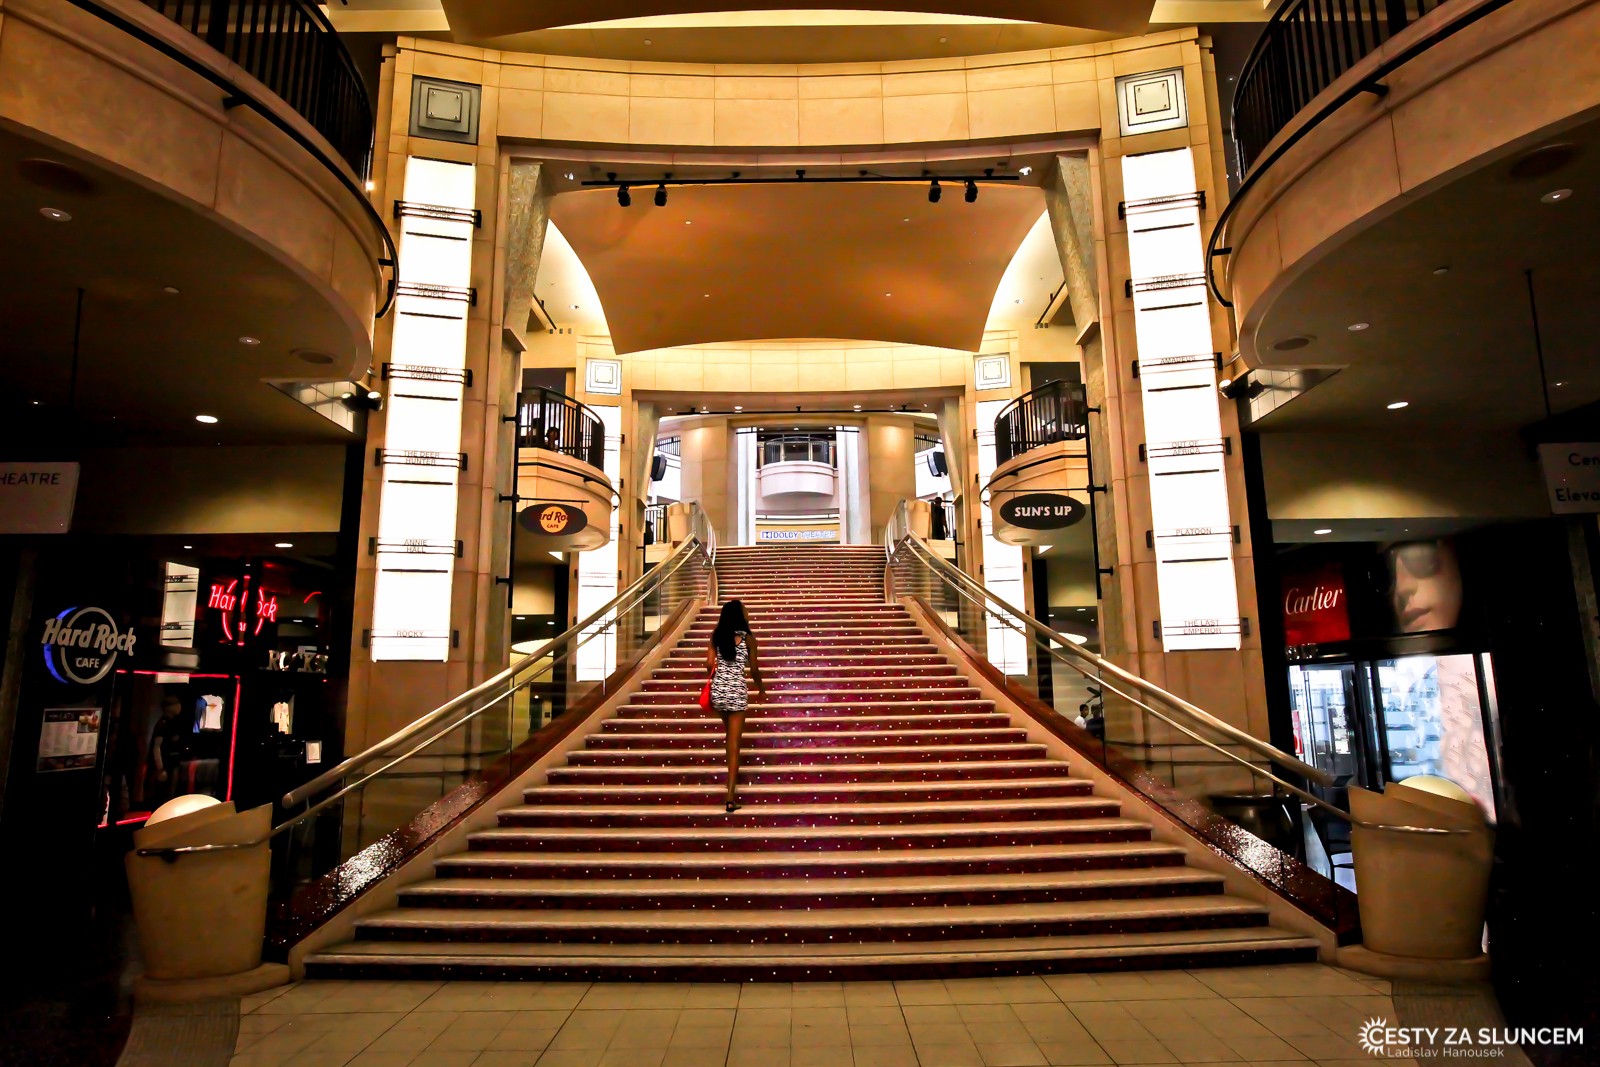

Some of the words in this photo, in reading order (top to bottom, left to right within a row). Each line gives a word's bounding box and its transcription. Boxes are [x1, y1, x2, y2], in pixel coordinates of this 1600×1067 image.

[1172, 447, 1201, 456] AFRICA
[1014, 506, 1051, 517] SUN'S
[1054, 505, 1073, 516] UP
[773, 531, 798, 539] DOLBY
[1175, 528, 1212, 536] PLATOON
[1285, 586, 1343, 615] Cartier
[1200, 619, 1220, 627] LAST
[1183, 627, 1222, 635] EMPEROR
[41, 617, 96, 648] Hard
[93, 622, 137, 657] Rock
[74, 657, 101, 669] CAFE
